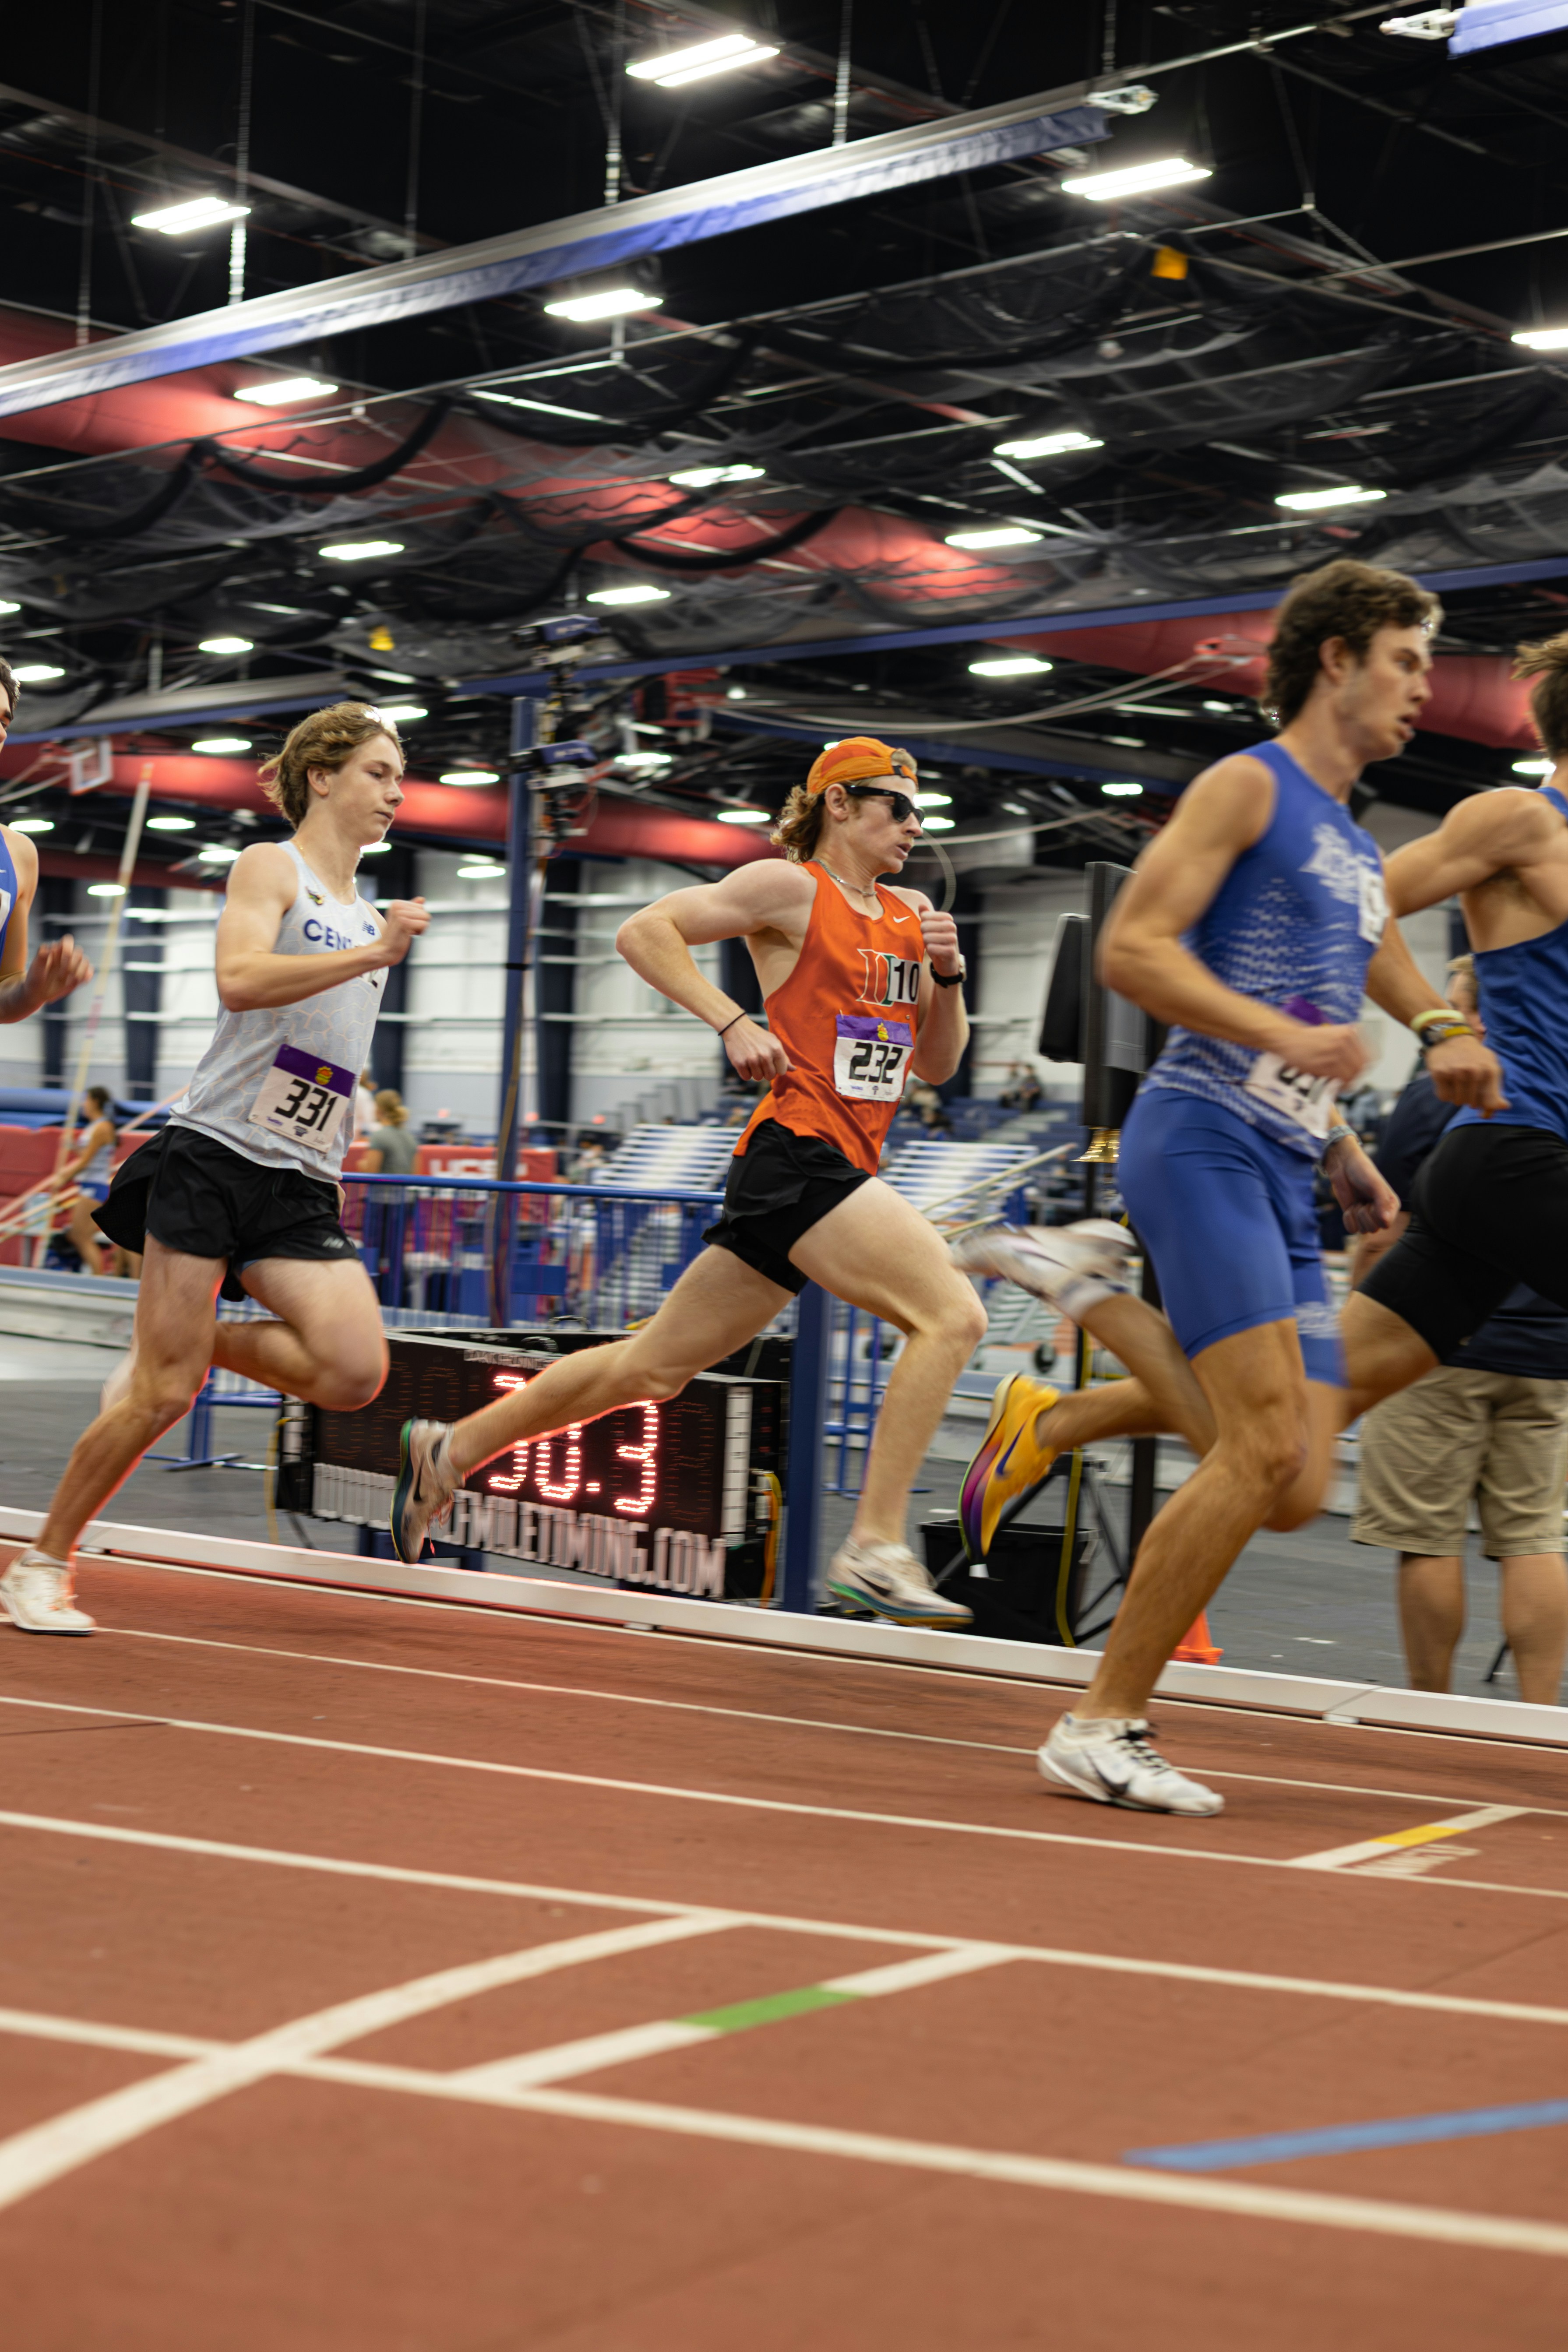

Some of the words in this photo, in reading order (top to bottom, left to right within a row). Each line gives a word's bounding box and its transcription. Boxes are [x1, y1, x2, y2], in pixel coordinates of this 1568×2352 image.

[894, 961, 920, 1002] 10
[849, 1042, 903, 1084] 232
[274, 1078, 339, 1131] 331
